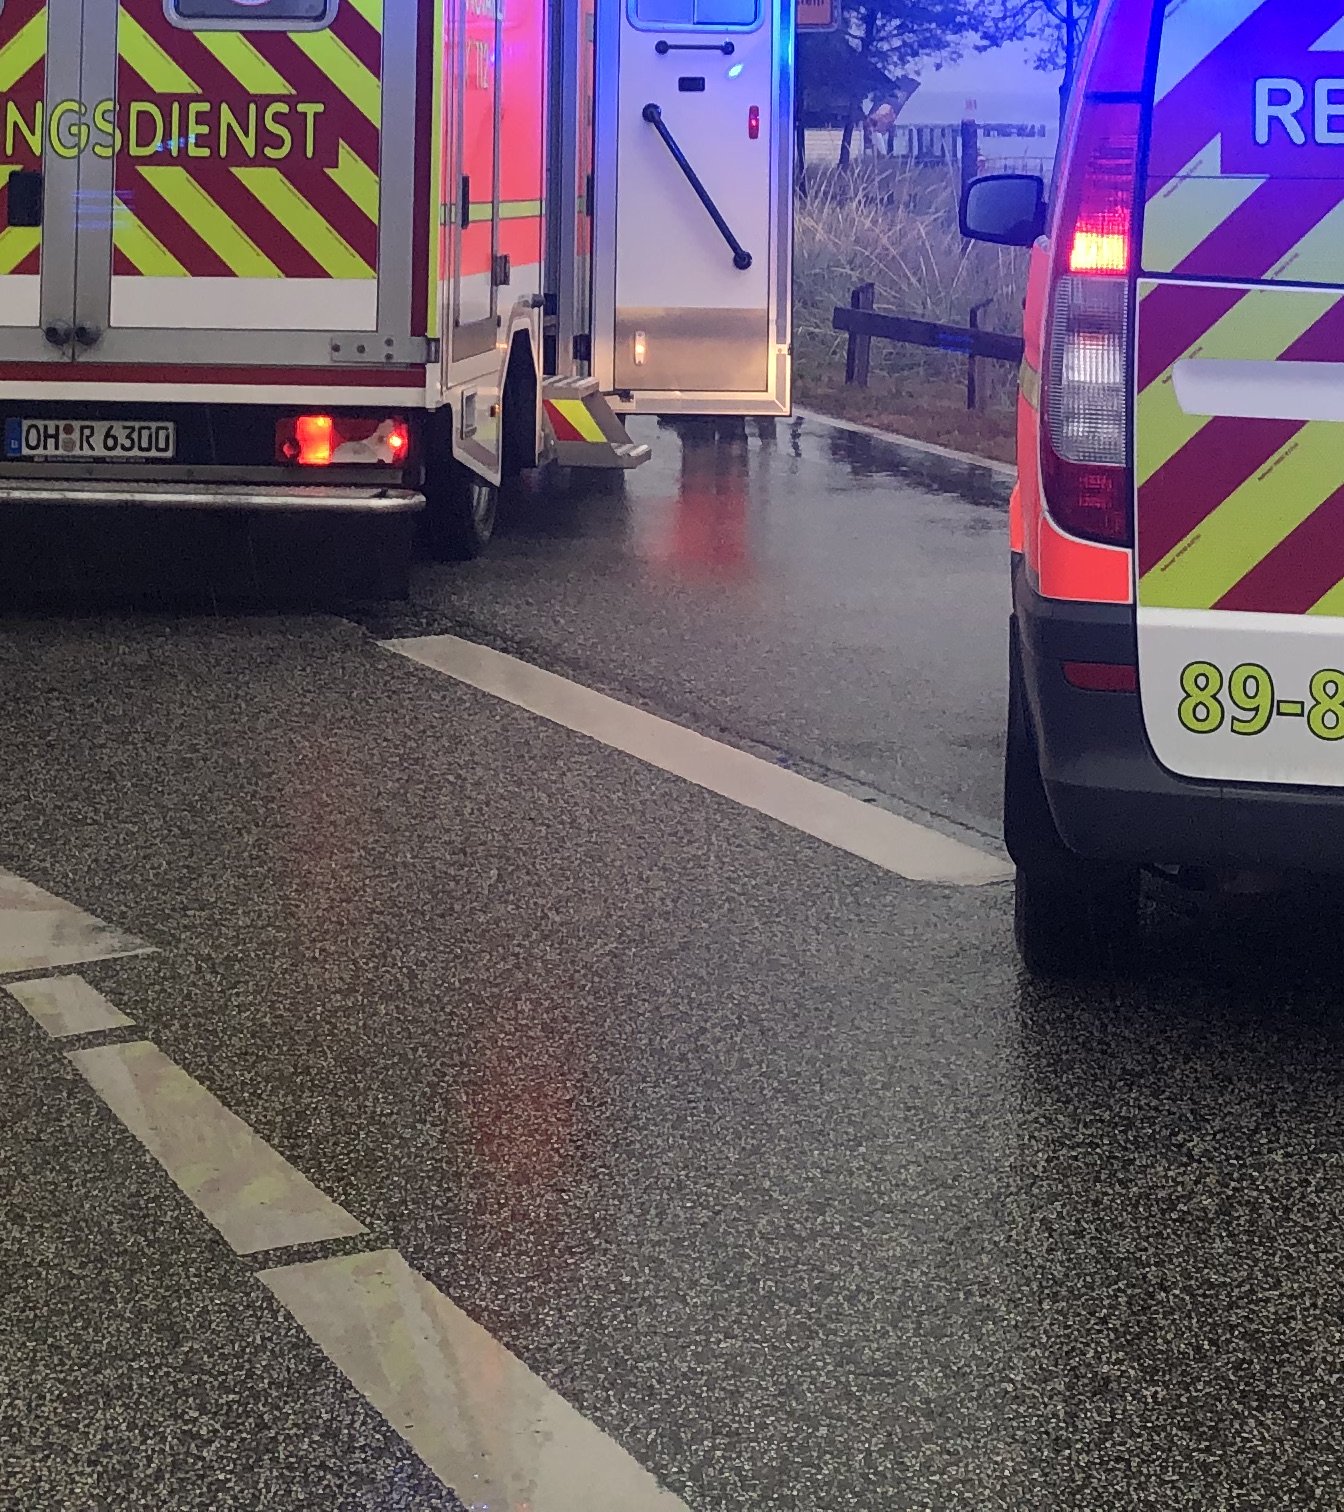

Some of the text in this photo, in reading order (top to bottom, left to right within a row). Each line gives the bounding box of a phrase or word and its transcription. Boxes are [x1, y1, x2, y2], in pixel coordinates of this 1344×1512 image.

[25, 424, 60, 451] OH
[79, 425, 95, 451] R
[103, 425, 170, 453] 6300
